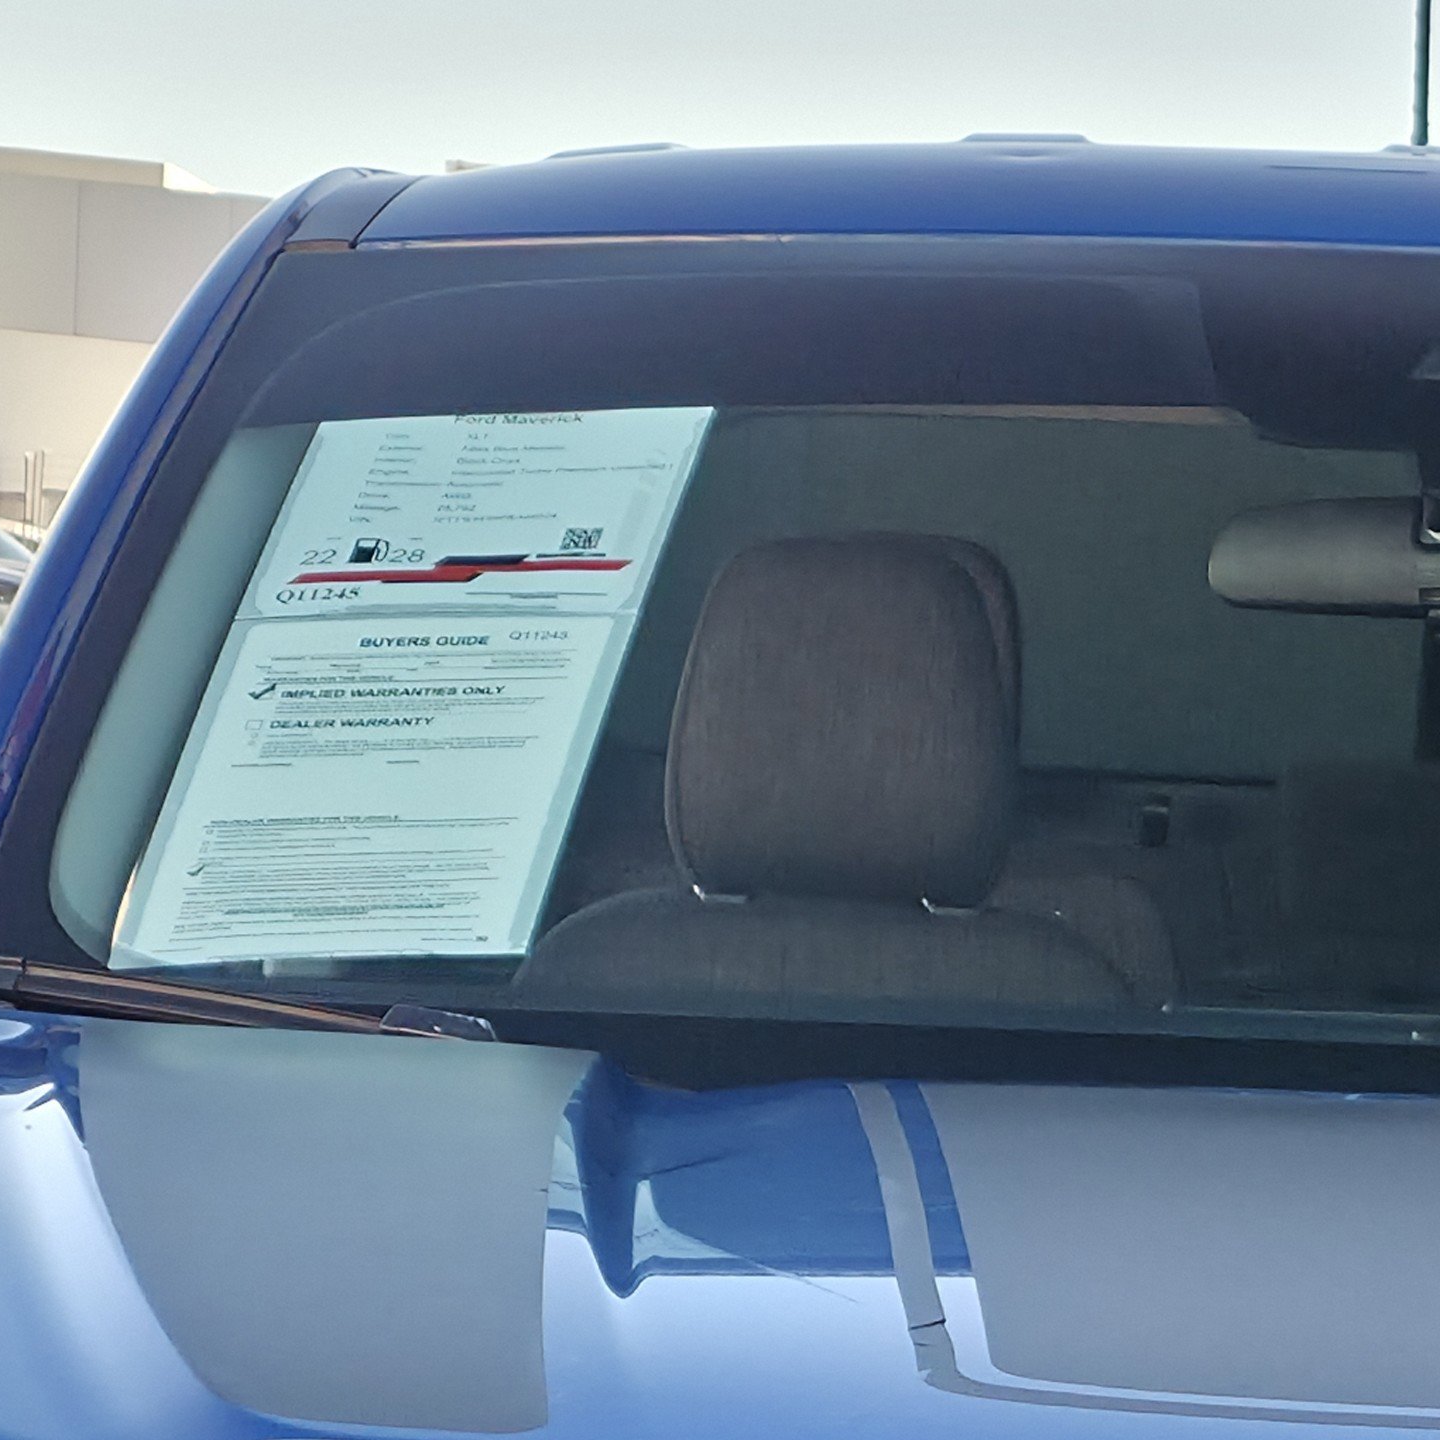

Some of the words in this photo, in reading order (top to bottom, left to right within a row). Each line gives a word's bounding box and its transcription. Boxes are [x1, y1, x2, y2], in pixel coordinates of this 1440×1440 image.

[454, 414, 497, 425] Ford
[500, 412, 585, 425] Maverick
[299, 550, 338, 566] 22
[389, 548, 426, 563] 28
[275, 586, 361, 605] Q11245
[358, 637, 431, 649] BUYERS
[435, 635, 491, 647] GUIDE
[280, 688, 346, 699] IMPLIED
[349, 686, 458, 698] WARRANTIES
[461, 684, 506, 696] ONLY
[269, 718, 336, 730] DEALER
[339, 715, 435, 728] WARRANTY
